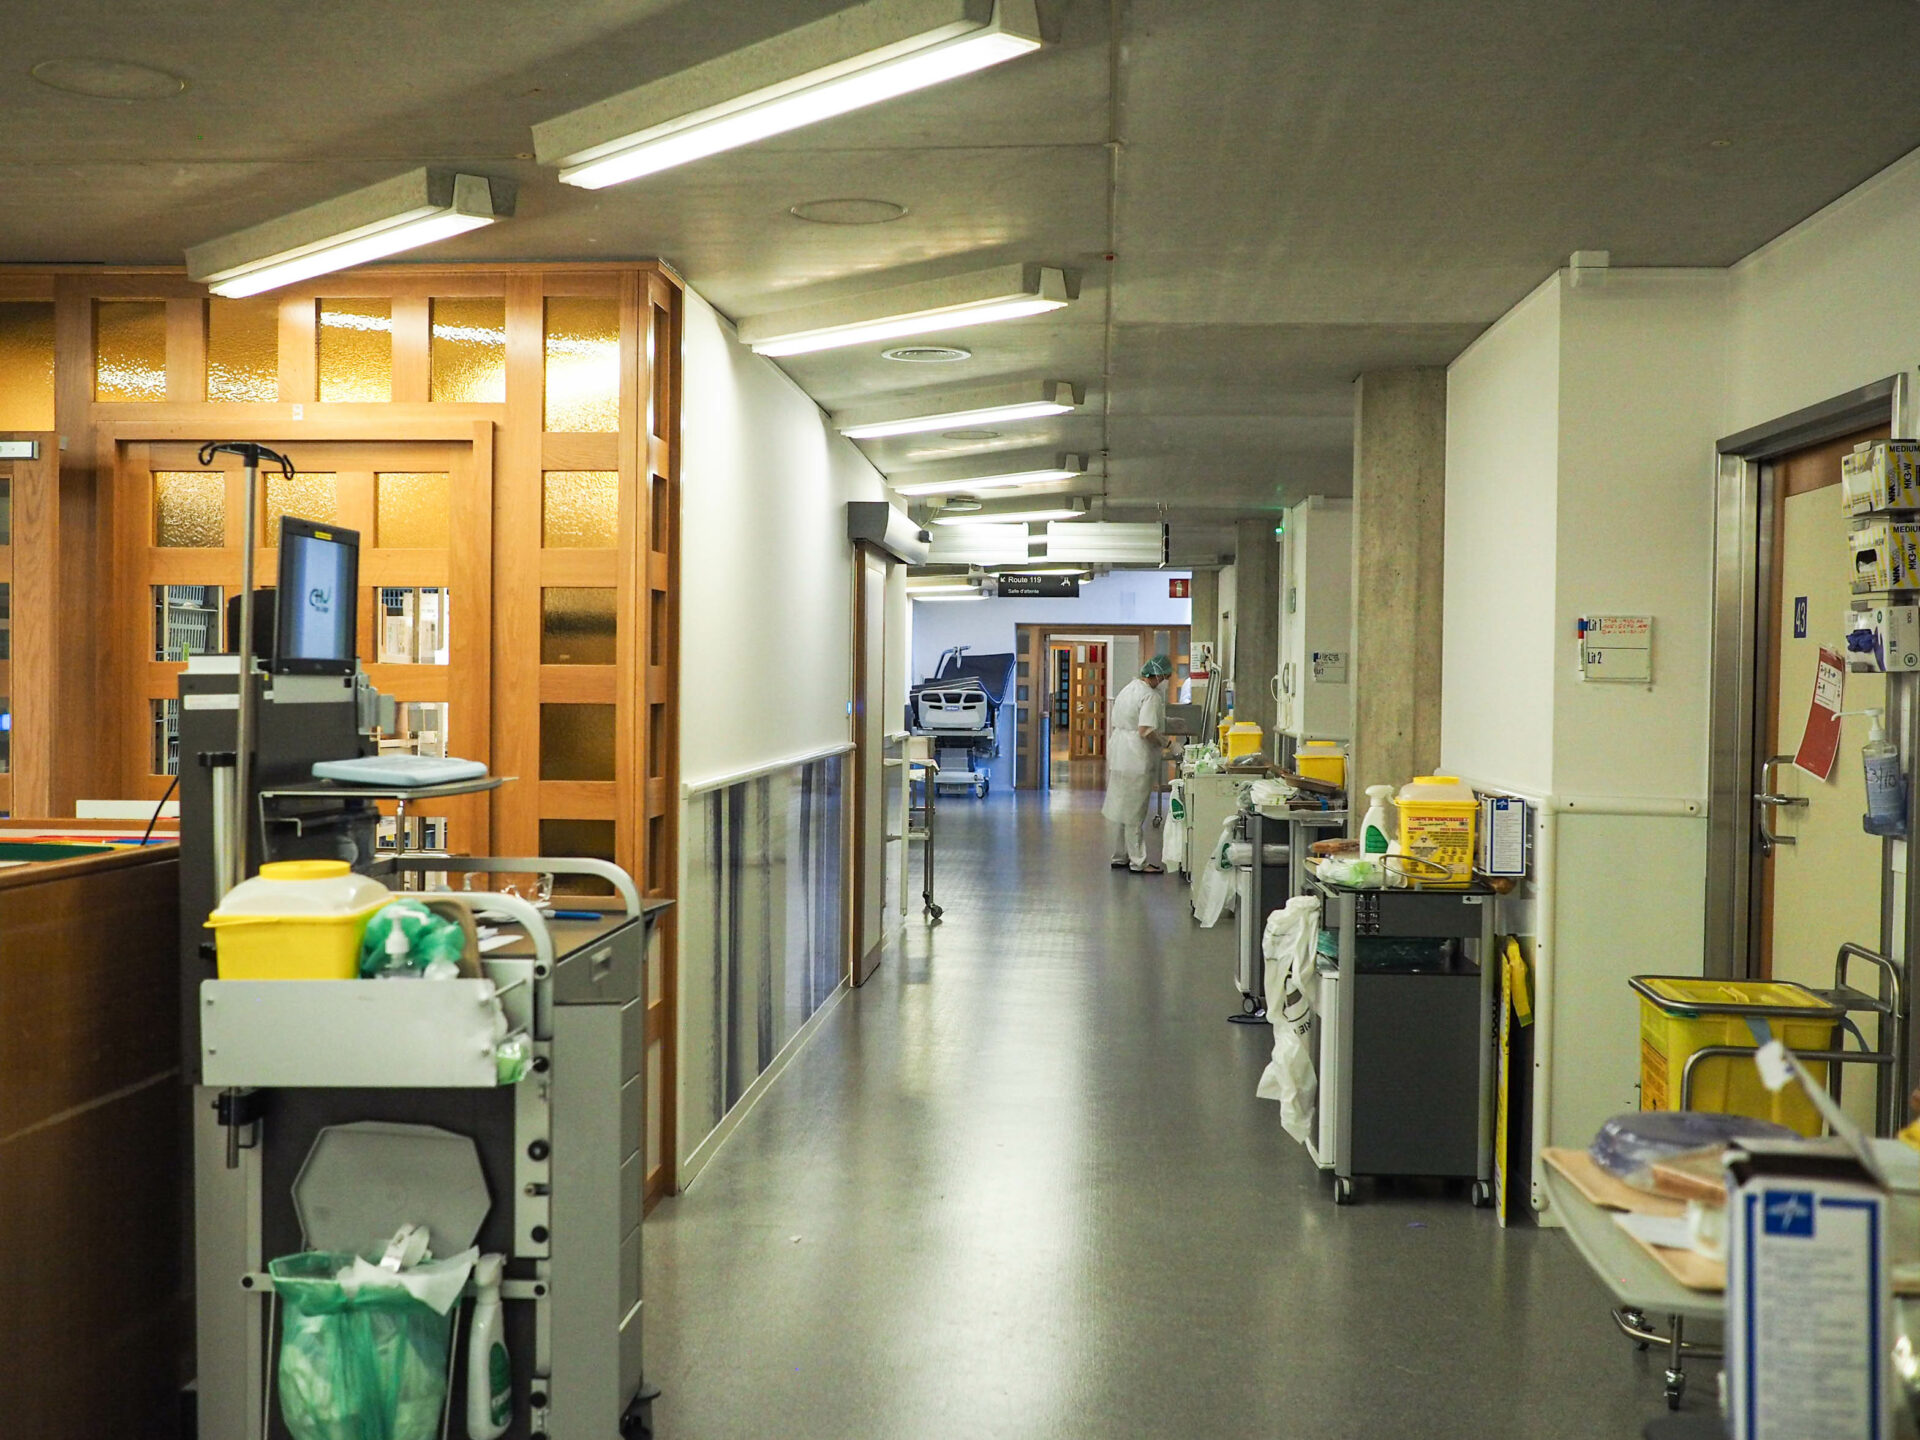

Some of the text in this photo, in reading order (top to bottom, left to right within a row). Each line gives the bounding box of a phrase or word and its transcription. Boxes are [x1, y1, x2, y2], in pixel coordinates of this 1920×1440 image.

[1889, 445, 1920, 453] MEDIUM
[1903, 463, 1911, 489] MK3-W
[1893, 525, 1920, 533] MEDIU
[1908, 543, 1917, 570] MK3-W
[1796, 602, 1805, 633] 43
[1588, 618, 1597, 631] Lit
[1588, 651, 1602, 664] Lit 2
